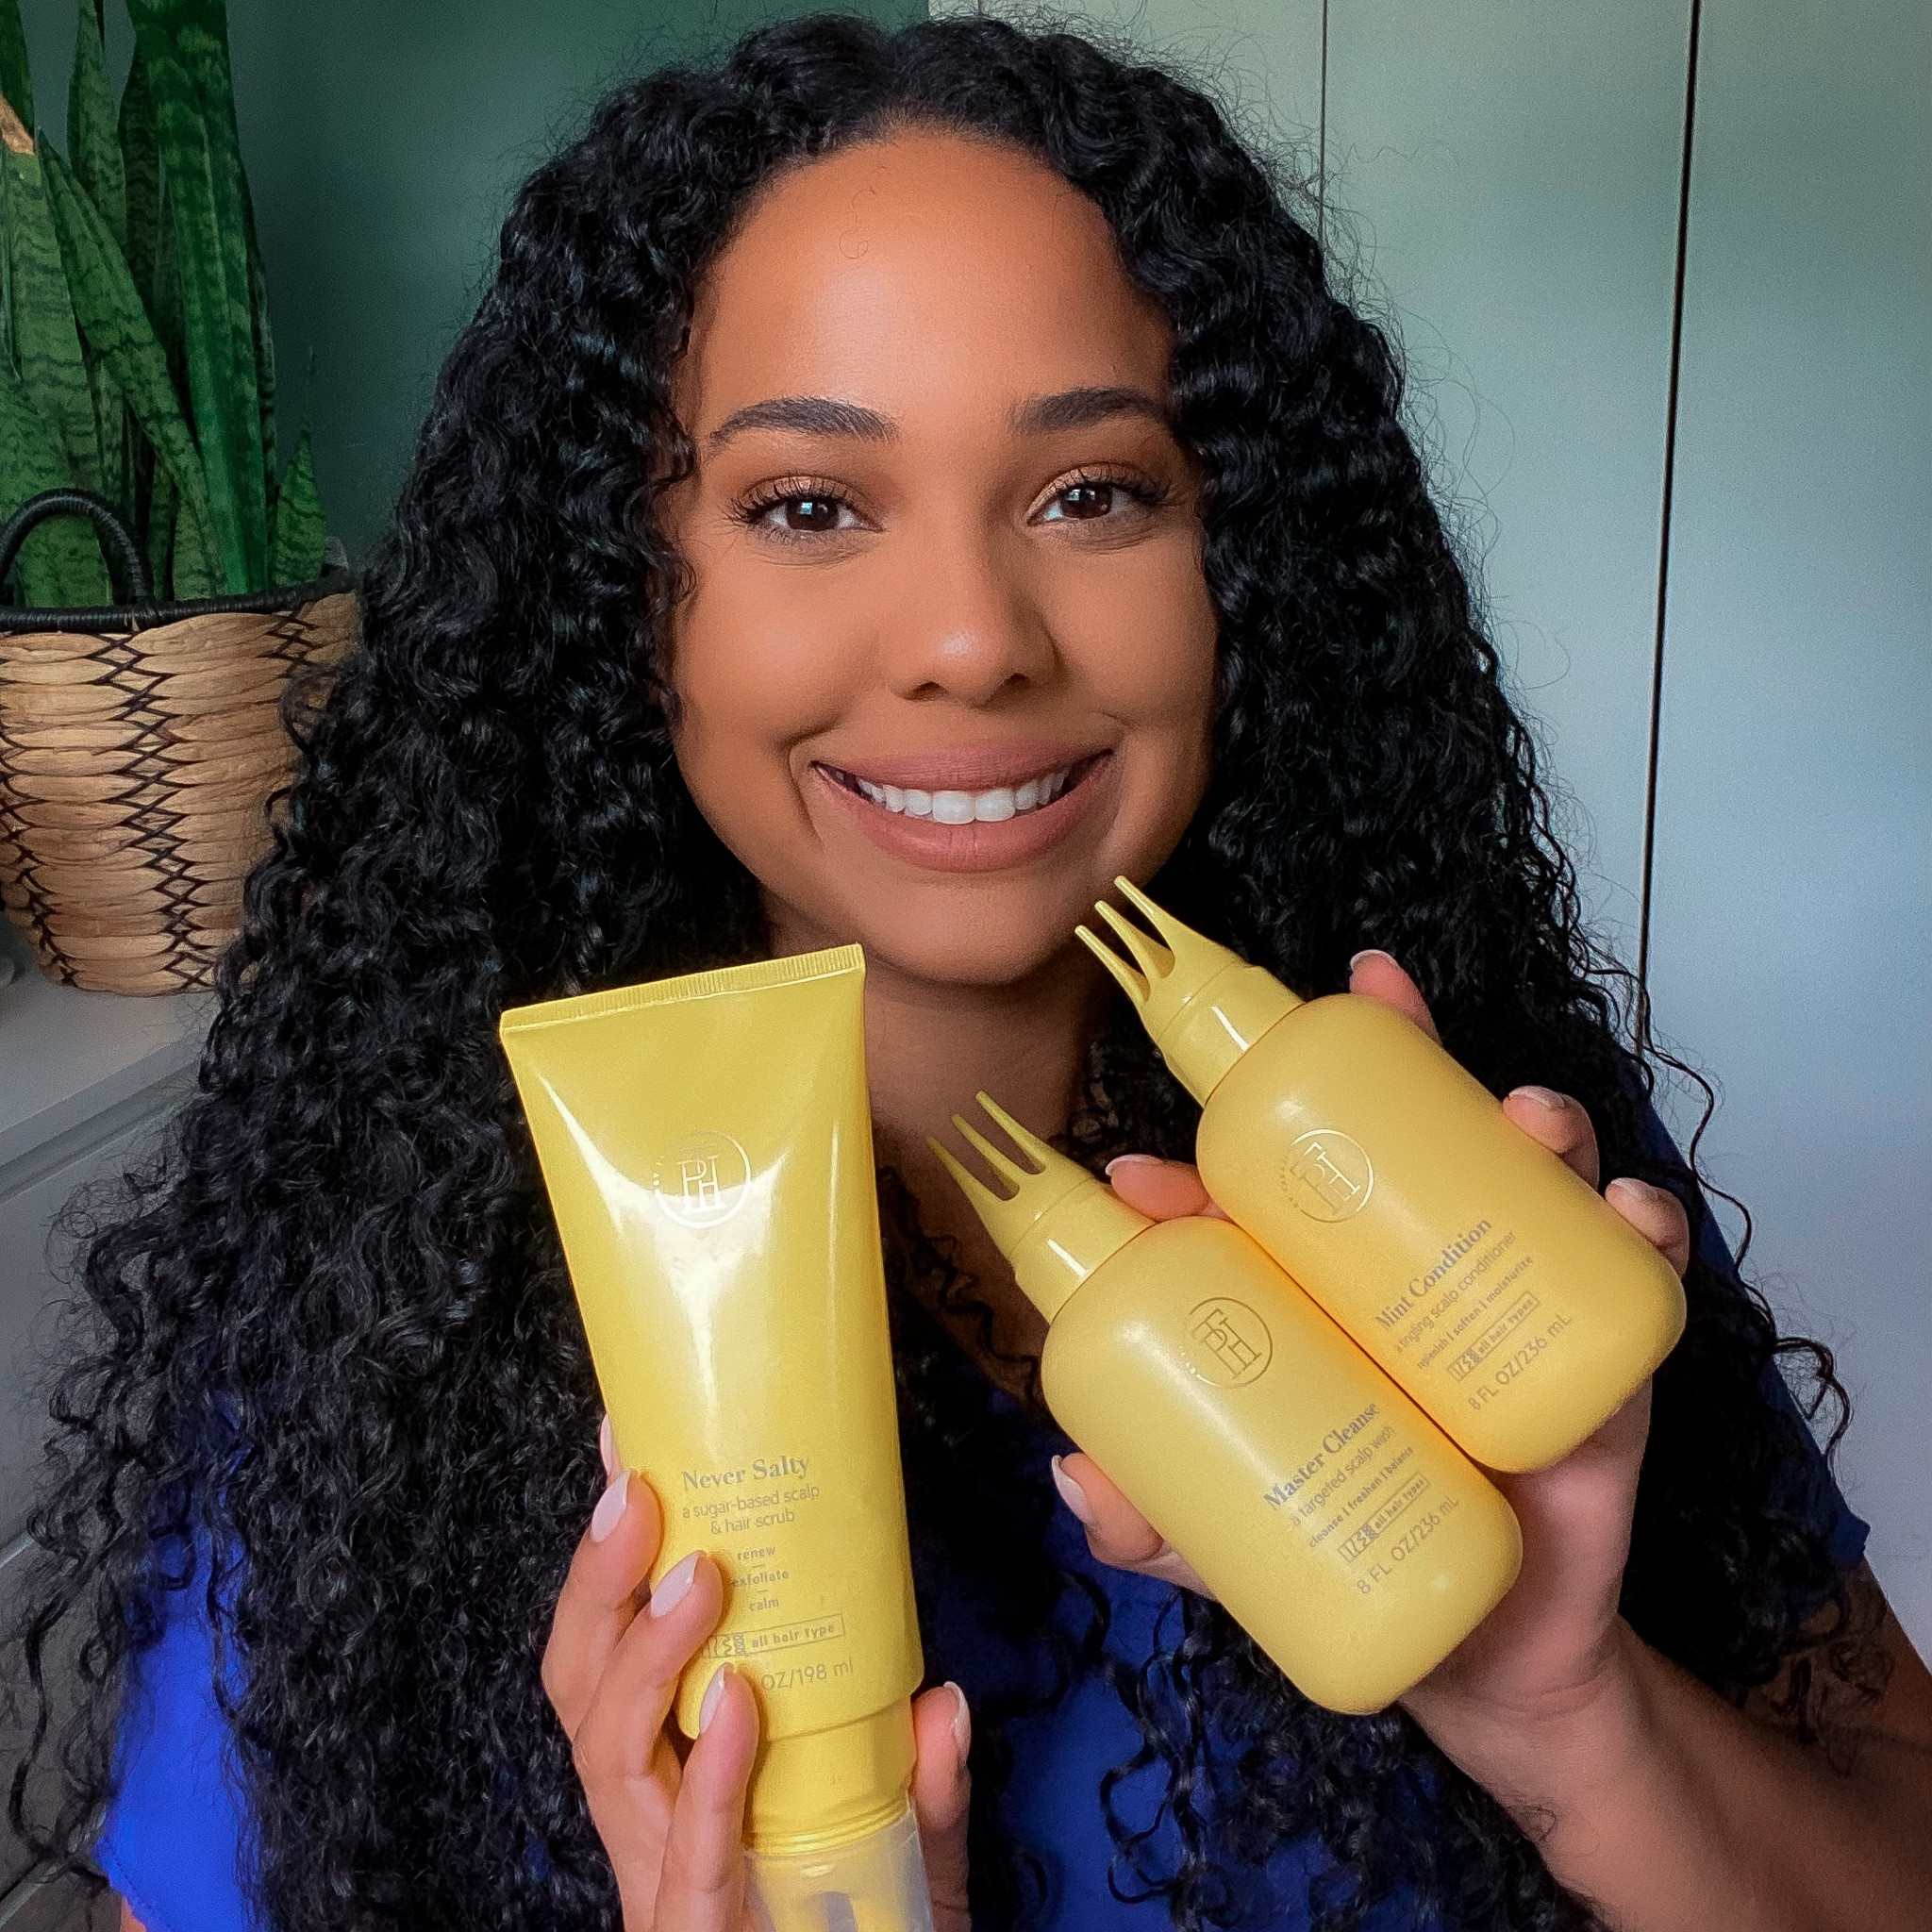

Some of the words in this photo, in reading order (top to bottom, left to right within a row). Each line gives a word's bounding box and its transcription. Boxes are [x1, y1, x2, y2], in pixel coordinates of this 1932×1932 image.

[1375, 1296, 1414, 1330] Mint
[1408, 1219, 1492, 1297] Condition
[1399, 1316, 1435, 1348] tingling
[1431, 1290, 1460, 1319] scalp
[1457, 1231, 1517, 1291] conditioner
[1453, 1307, 1482, 1336] soften
[1486, 1257, 1533, 1303] moisturize
[1478, 1339, 1491, 1354] all
[1489, 1323, 1508, 1341] hair
[1509, 1299, 1534, 1324] types
[1468, 1396, 1482, 1410] 8
[1476, 1385, 1499, 1404] FL
[1495, 1336, 1548, 1386] OZ/236
[1548, 1314, 1572, 1339] mL
[682, 1469, 746, 1491] Never
[752, 1455, 810, 1480] Salty
[1263, 1453, 1325, 1510] Master
[1323, 1403, 1380, 1453] Cleanse
[1291, 1516, 1302, 1527] a
[1299, 1468, 1347, 1519] targeted
[1345, 1445, 1374, 1474] scalp
[1371, 1424, 1396, 1449] wash
[683, 1507, 691, 1519] a
[693, 1491, 780, 1520] sugar-based
[784, 1484, 820, 1504] scalp
[710, 1521, 722, 1535] &
[725, 1516, 751, 1532] hair
[756, 1508, 795, 1527] scrub
[1309, 1514, 1344, 1548] cleanse
[1347, 1477, 1383, 1511] freshen
[1384, 1446, 1414, 1474] balance
[1374, 1513, 1387, 1529] all
[1385, 1498, 1404, 1517] hair
[1402, 1479, 1425, 1501] types
[737, 1546, 776, 1561] renew
[1357, 1579, 1371, 1594] 8
[1370, 1563, 1392, 1583] FL
[1391, 1512, 1441, 1562] OZ/236
[1440, 1496, 1460, 1516] mL
[733, 1569, 790, 1588] exfoliate
[749, 1597, 779, 1612] calm
[751, 1636, 768, 1649] all
[773, 1630, 800, 1644] hair
[804, 1624, 835, 1641] type
[761, 1664, 827, 1690] OZ/198
